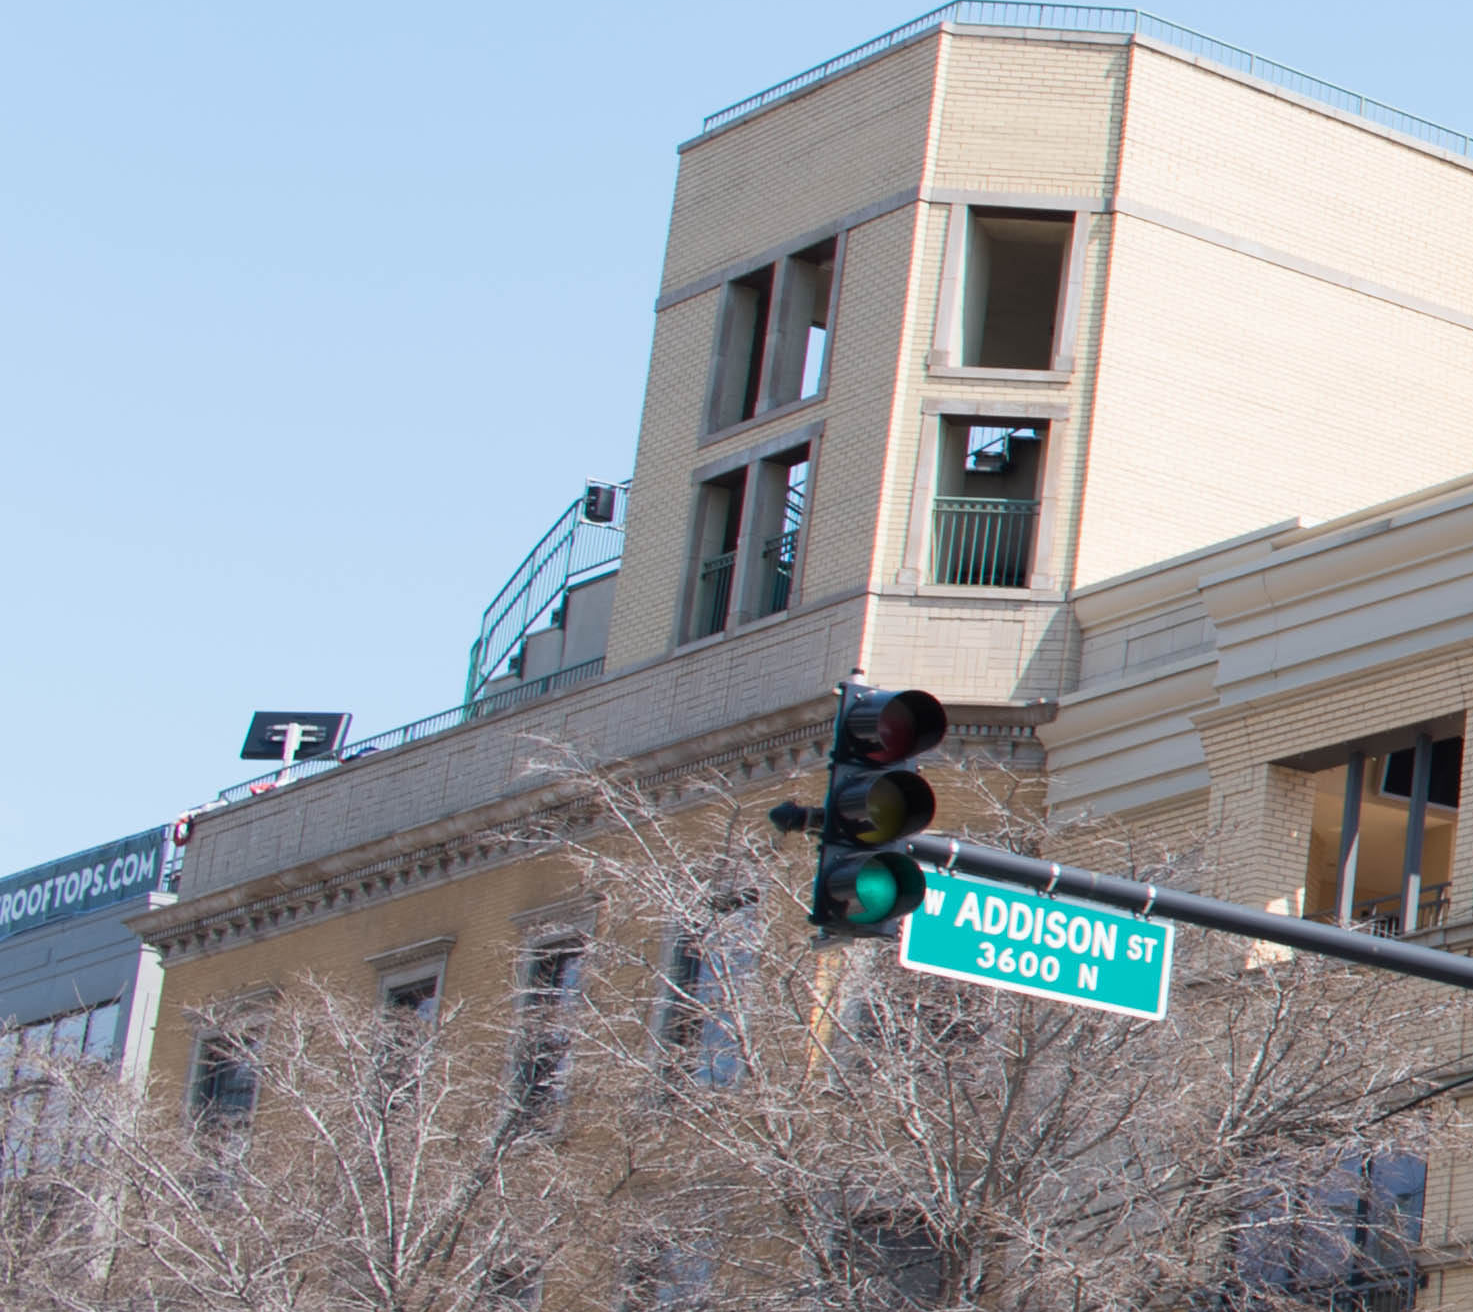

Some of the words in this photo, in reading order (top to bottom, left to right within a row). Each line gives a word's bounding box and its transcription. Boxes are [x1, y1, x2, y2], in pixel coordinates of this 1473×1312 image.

[0, 847, 157, 925] ROOFTOPS.COM
[924, 887, 946, 917] W
[954, 891, 1118, 961] ADDISON
[1126, 934, 1158, 964] ST
[976, 941, 1061, 983] 3600
[1077, 962, 1099, 991] N
